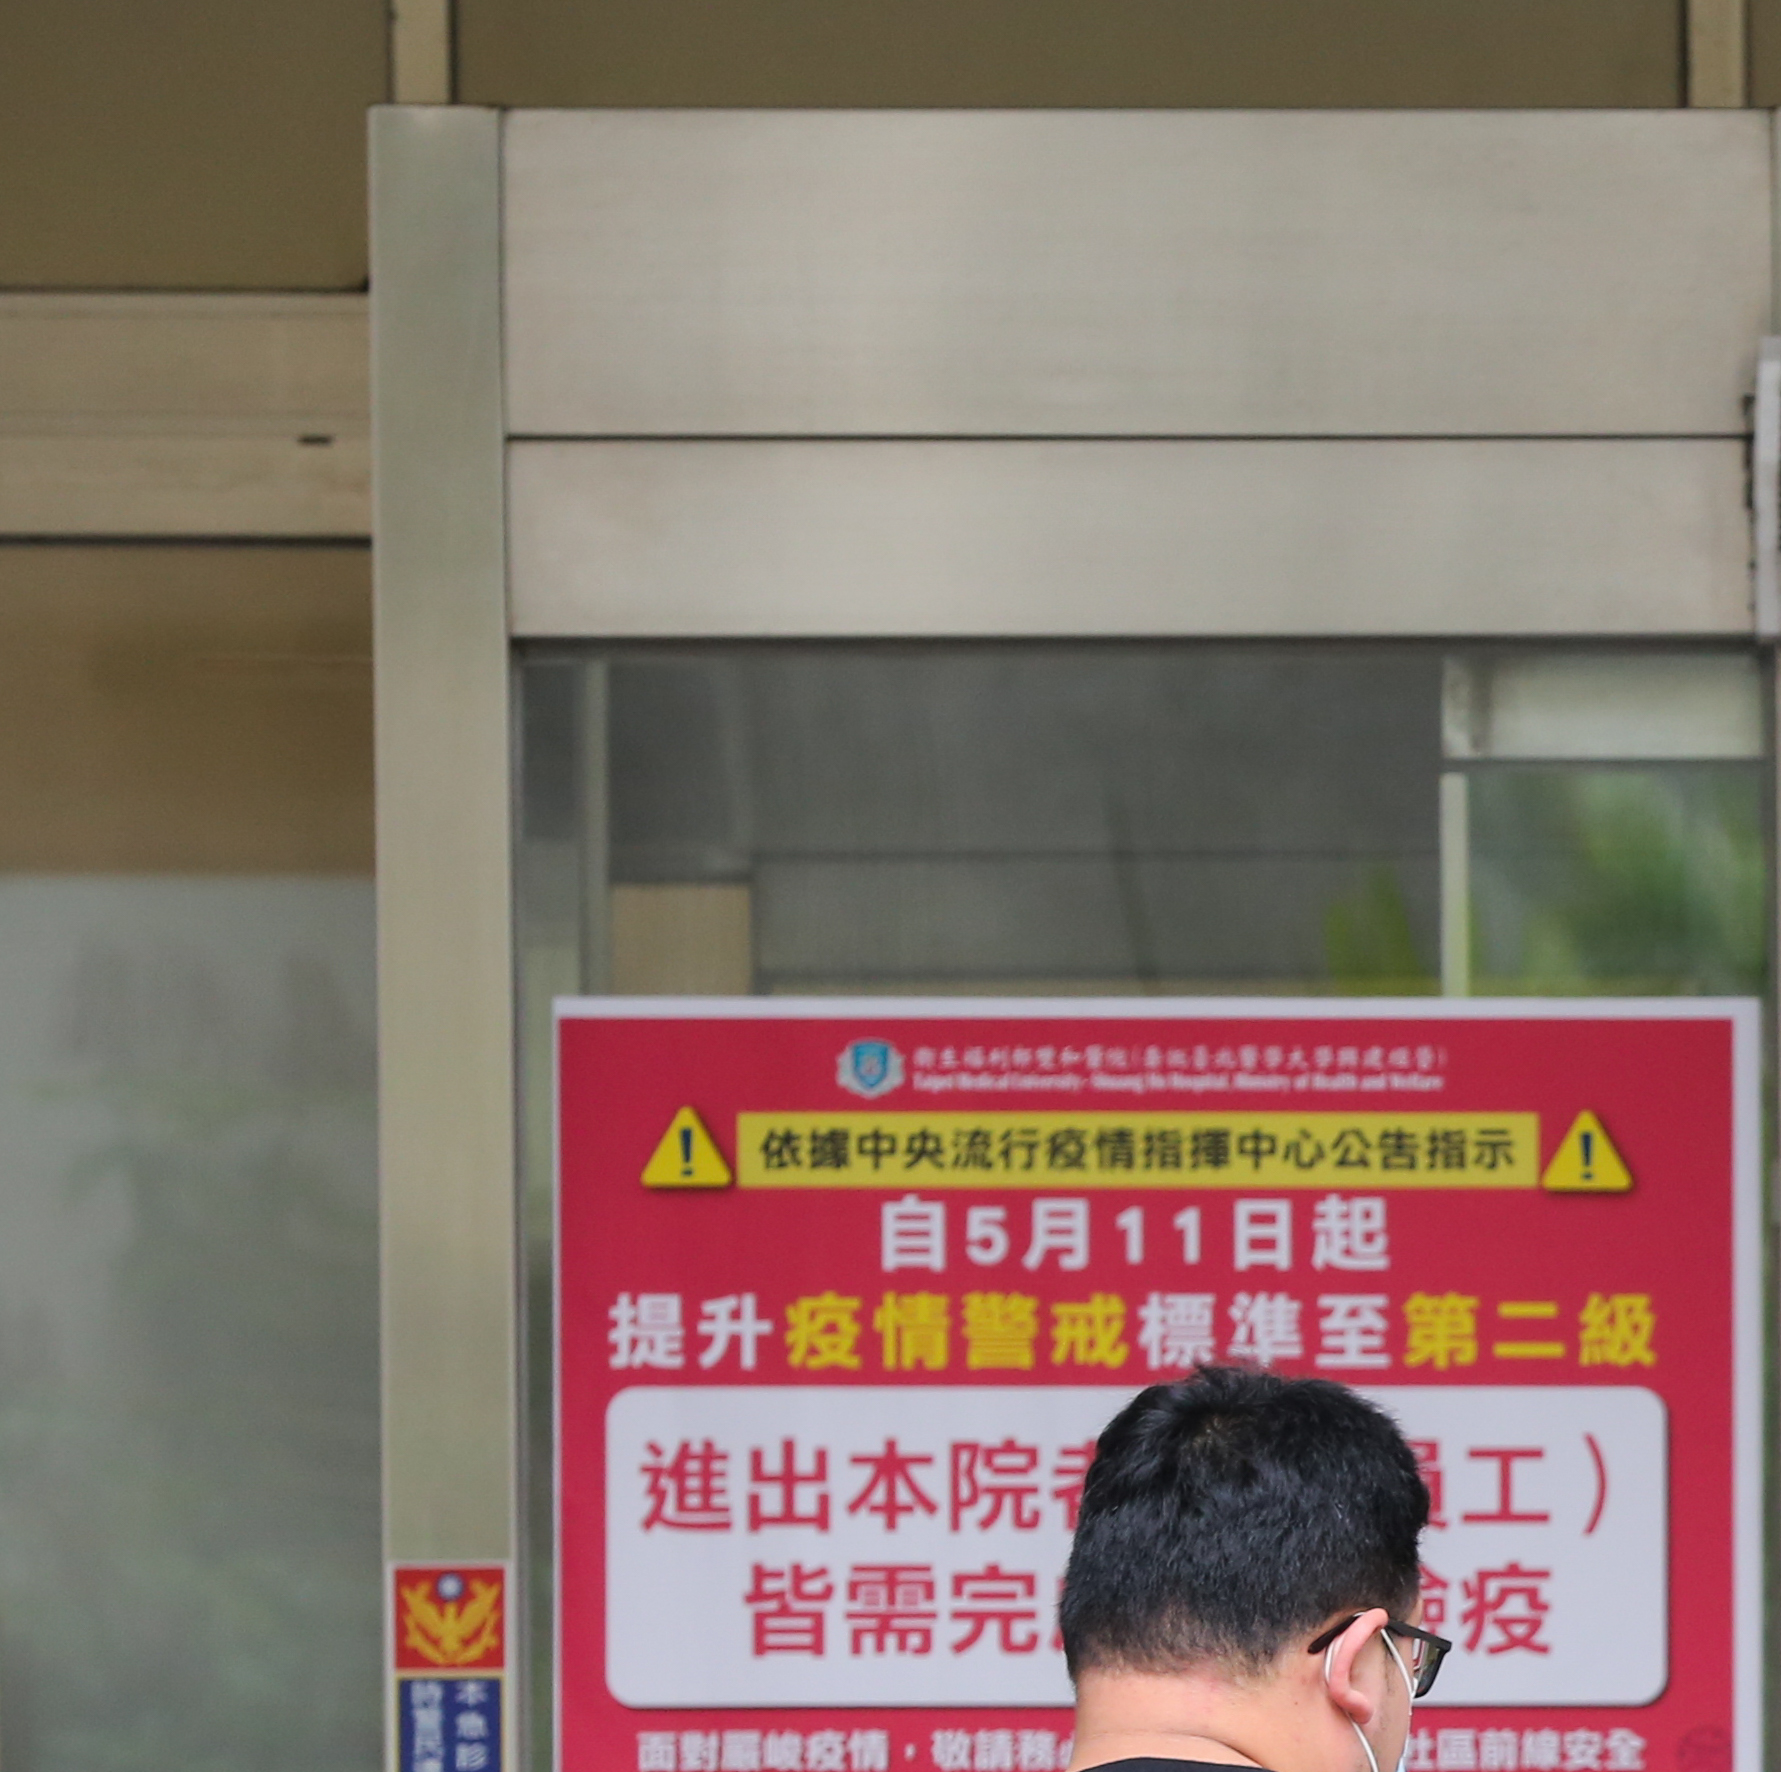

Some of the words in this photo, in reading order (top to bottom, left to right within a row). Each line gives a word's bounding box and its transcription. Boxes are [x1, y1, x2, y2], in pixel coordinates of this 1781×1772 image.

[760, 1127, 1517, 1171] 依據中央流行疫情指揮中心公告指示
[882, 1194, 1391, 1272] 自5月11日起
[608, 1291, 1657, 1370] 提升疫情警戒標準至第二級
[745, 1563, 1066, 1656] 皆需完
